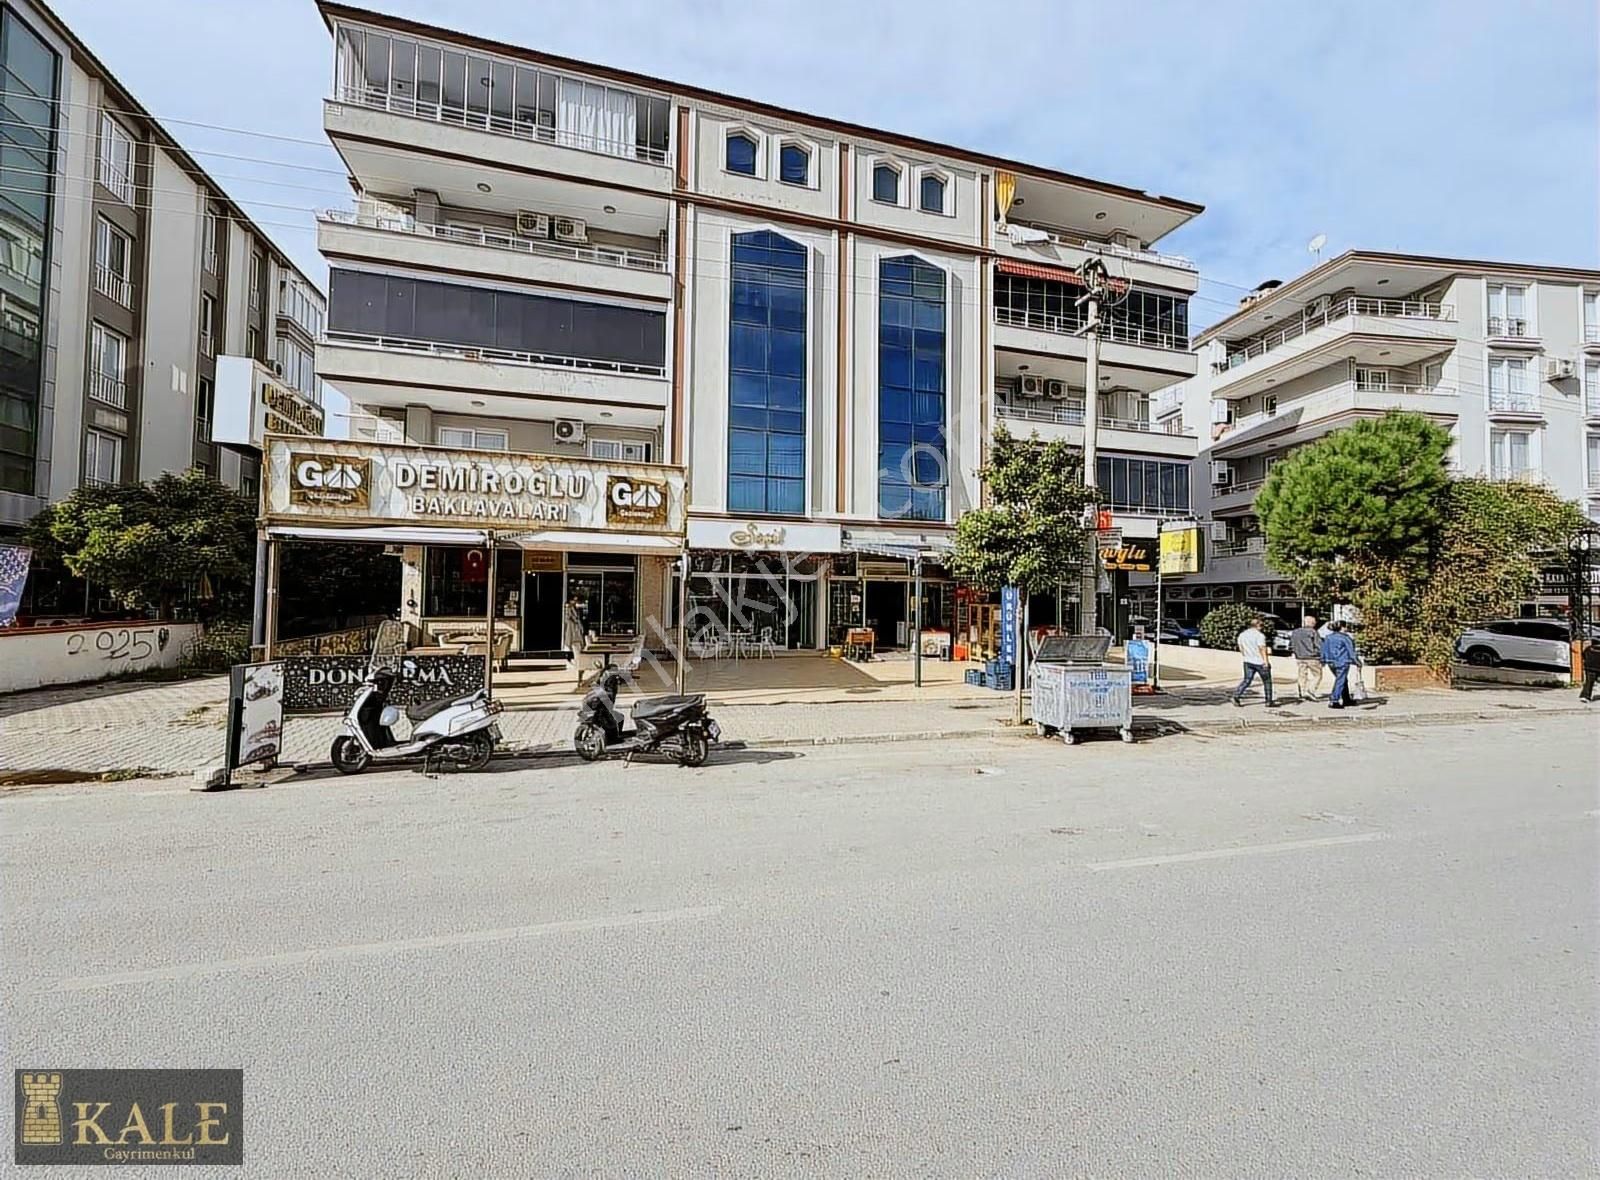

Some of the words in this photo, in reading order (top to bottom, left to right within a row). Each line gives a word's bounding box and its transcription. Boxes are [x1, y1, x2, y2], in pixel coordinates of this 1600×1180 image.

[395, 462, 587, 499] DEMİROĞLU
[411, 495, 570, 522] BAKLAVALARI
[67, 629, 155, 661] 2025
[309, 667, 455, 686] DONRMA
